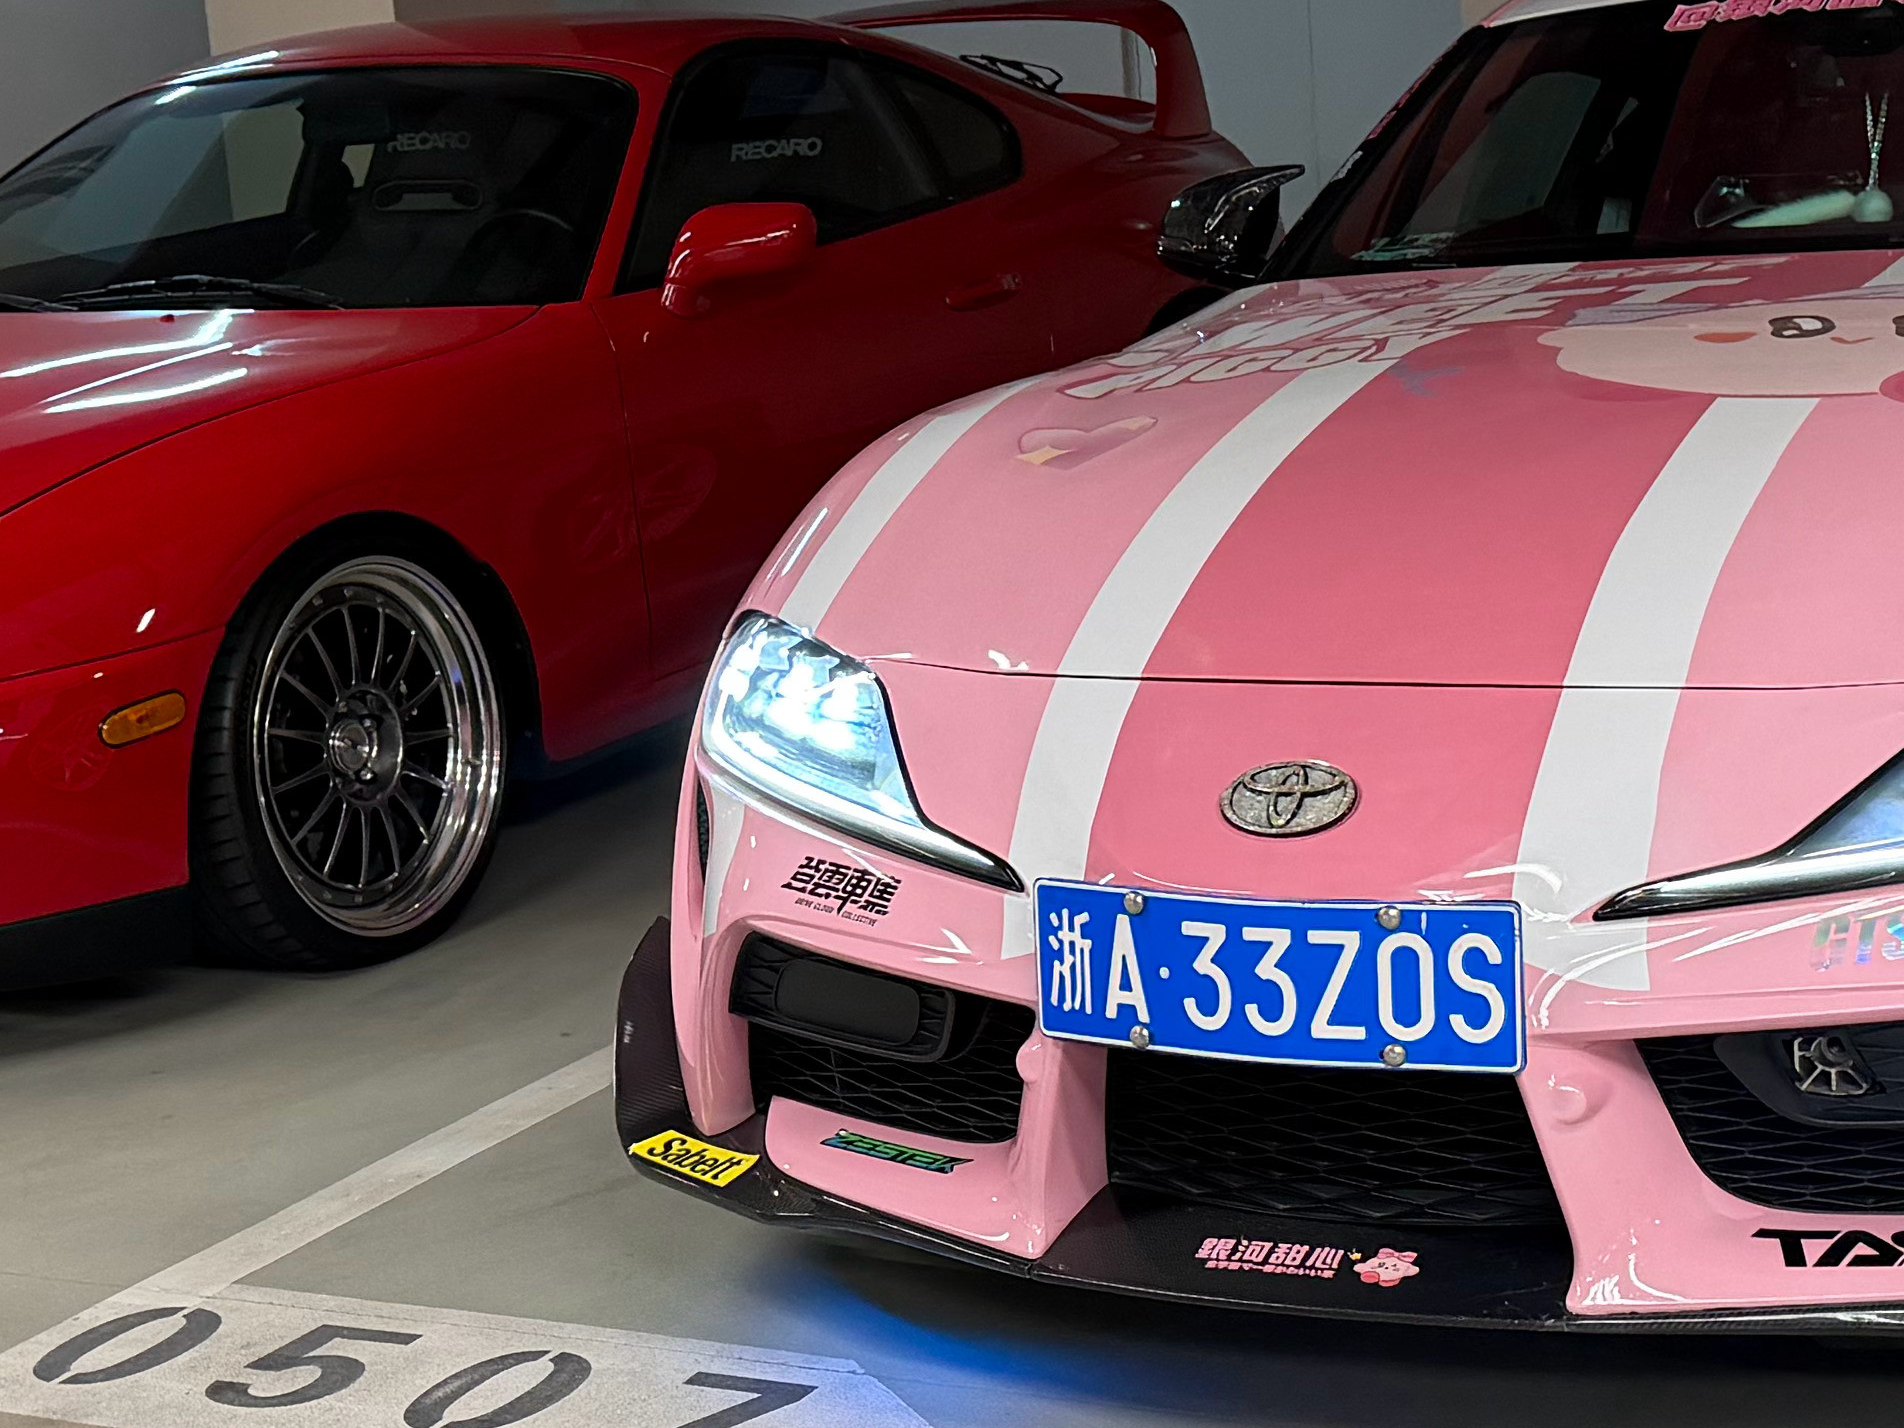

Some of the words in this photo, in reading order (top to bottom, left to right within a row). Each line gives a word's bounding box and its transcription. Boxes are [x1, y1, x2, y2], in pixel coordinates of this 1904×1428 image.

[387, 130, 470, 154] RECARO
[731, 136, 823, 163] RECARO
[1048, 908, 1507, 1044] 浙A·33Z0S
[647, 1137, 744, 1181] Sabelt
